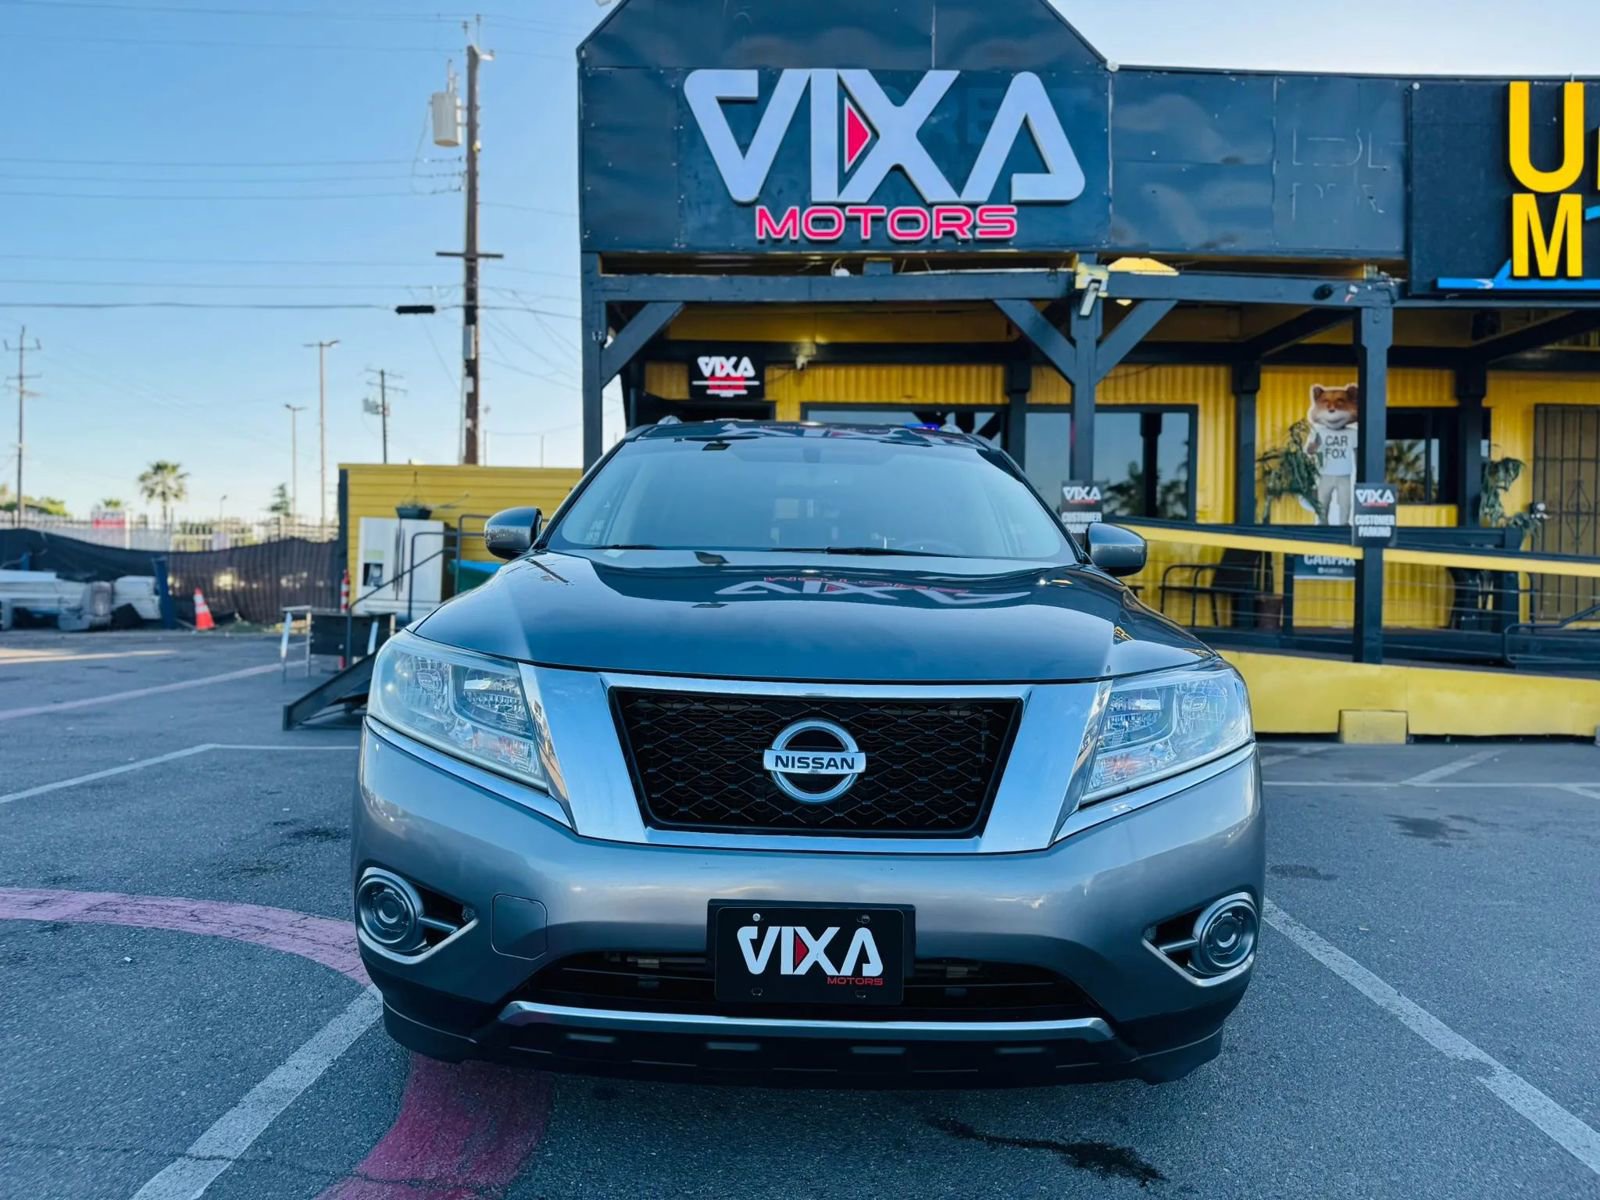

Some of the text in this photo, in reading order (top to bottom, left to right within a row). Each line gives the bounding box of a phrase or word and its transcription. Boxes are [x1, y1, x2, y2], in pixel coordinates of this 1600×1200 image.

[684, 69, 1085, 203] VIXA
[1509, 81, 1600, 193] U
[755, 205, 1017, 241] MOTORS
[697, 356, 756, 377] VIXA
[1325, 435, 1348, 446] CAR
[1325, 448, 1346, 459] FOX
[1062, 486, 1101, 500] VIXA
[1355, 489, 1395, 503] VIXA
[1355, 514, 1395, 526] CUSTOMER
[1358, 526, 1391, 537] PARKING
[775, 755, 855, 770] NISSAN
[737, 926, 883, 976] VIXA
[827, 976, 884, 986] MOTORS
